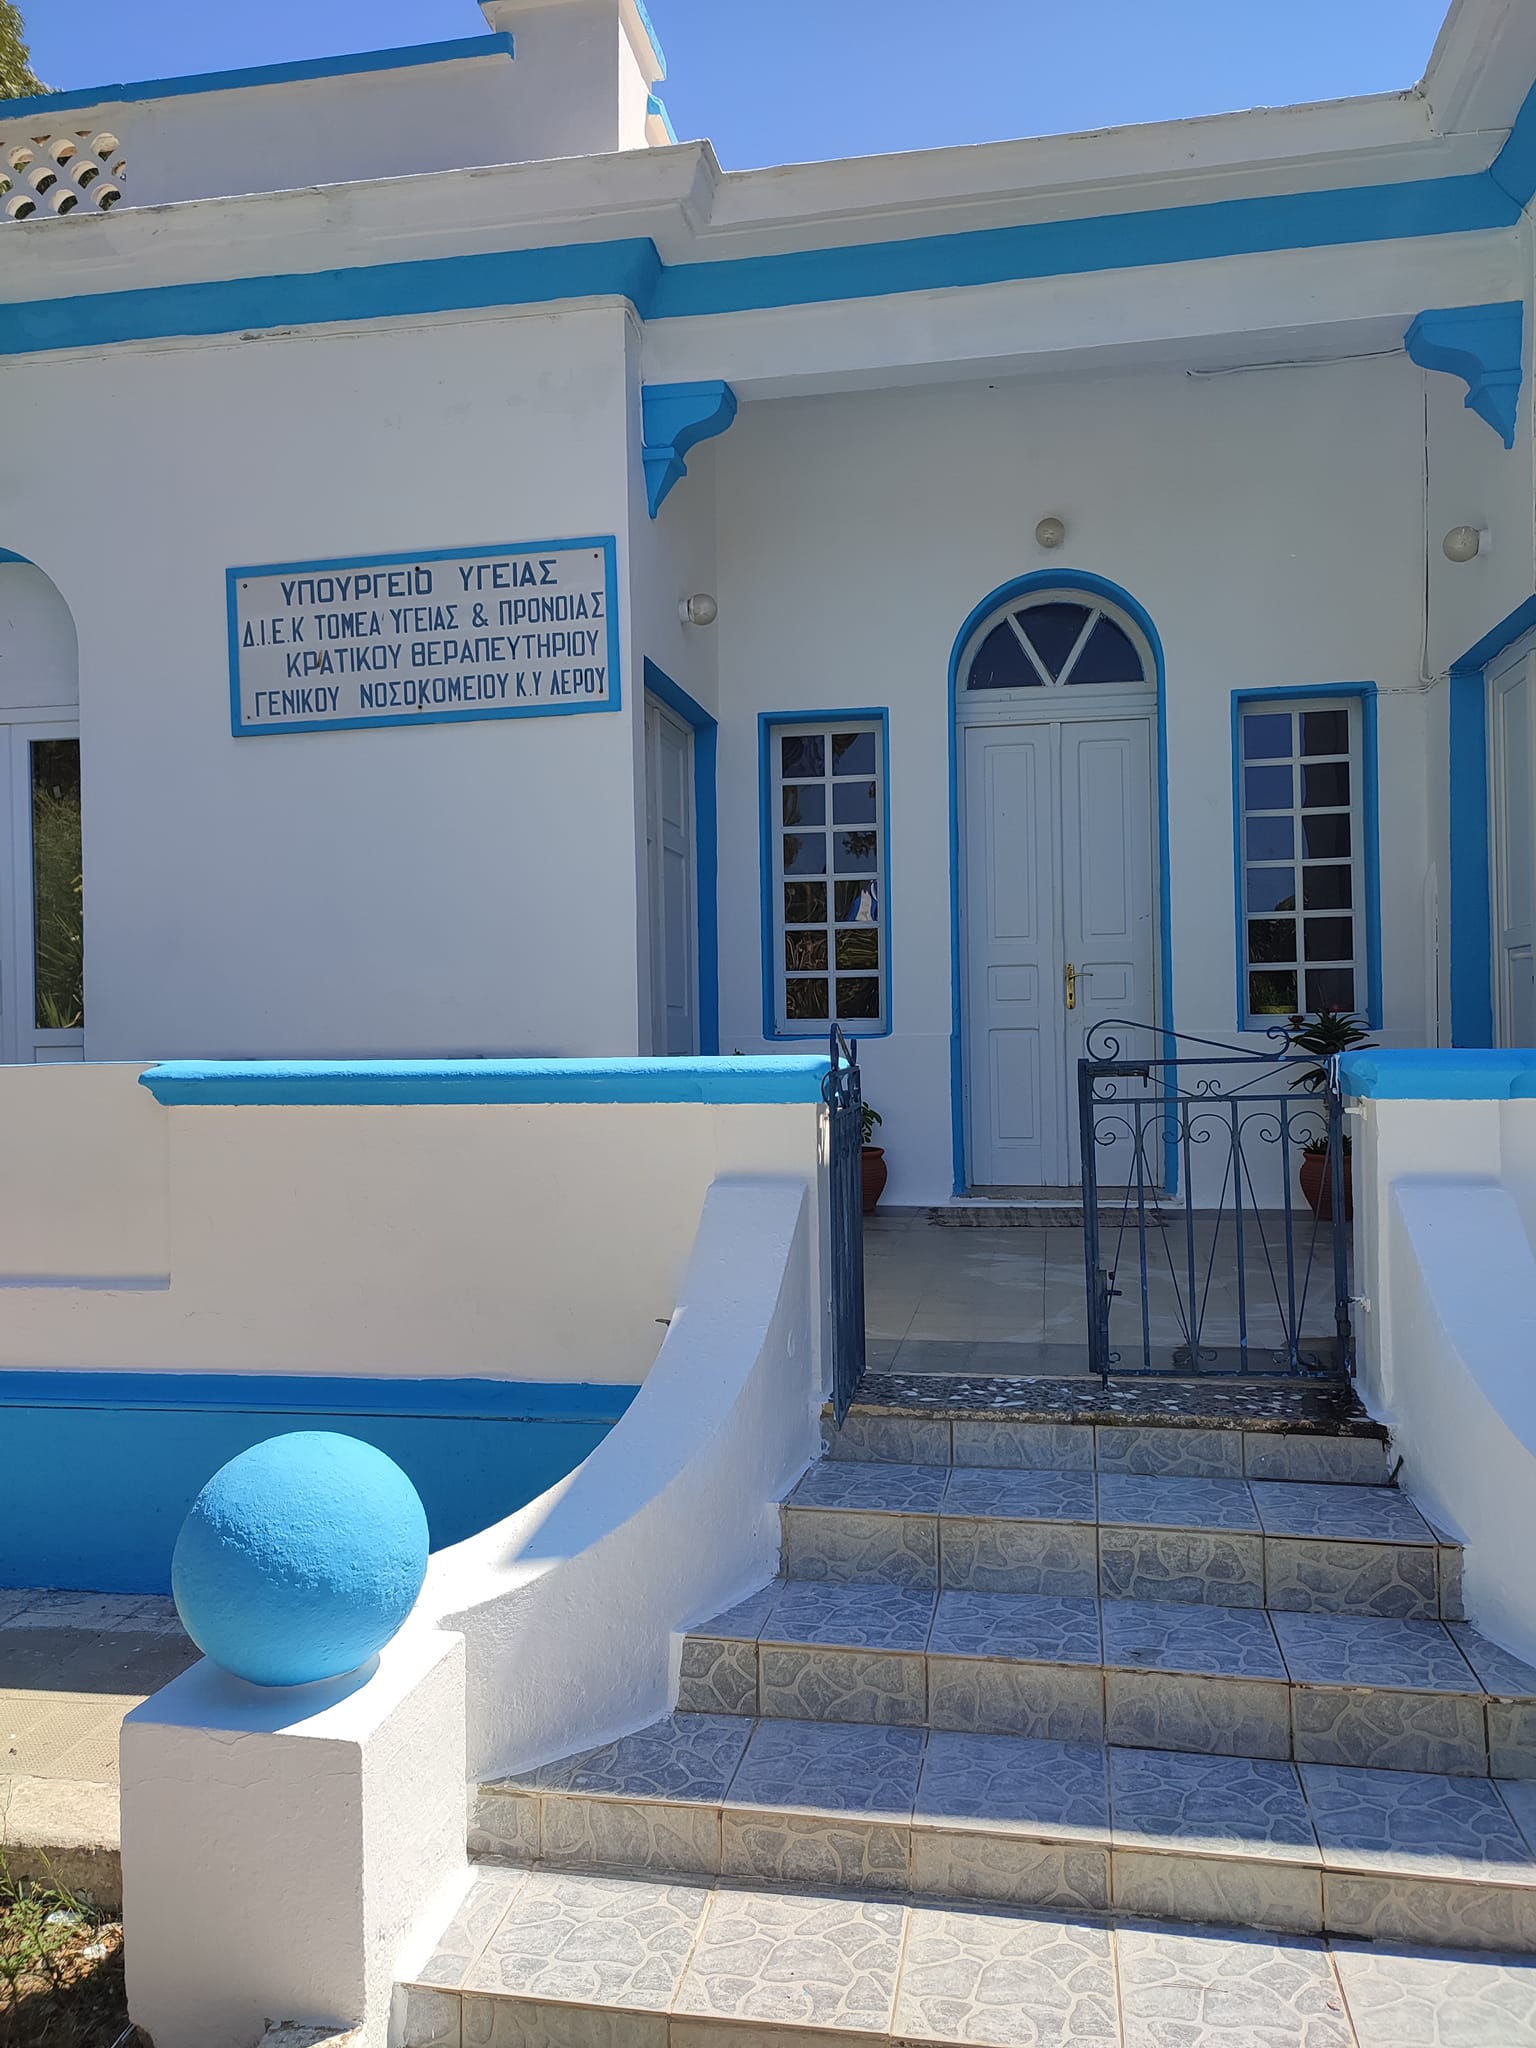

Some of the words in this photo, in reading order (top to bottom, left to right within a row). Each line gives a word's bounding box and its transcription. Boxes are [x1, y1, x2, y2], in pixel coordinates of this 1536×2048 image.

[280, 569, 433, 606] ΥΠΟΥΡΓΕΙΟ
[458, 559, 558, 592] ΥΓΕΙΑΣ
[314, 610, 381, 641] ΤΟΜΕΑ
[389, 604, 459, 635] ΥΓΕΙΑΣ
[472, 602, 489, 628] &
[499, 591, 605, 626] ΠΡΟΝΟΙΑΣ
[286, 643, 403, 678] ΚΡΑΤΙΚΟΥ
[411, 629, 600, 668] ΘΕΡΑΠΕΥΤΗΡΙΟΥ
[255, 686, 340, 717] ΓΕΝΙΚΟΥ
[360, 672, 509, 709] ΝΟΣΟΚΟΜΕΙΟΥ
[550, 667, 606, 696] ΛΕΡΟΥ
